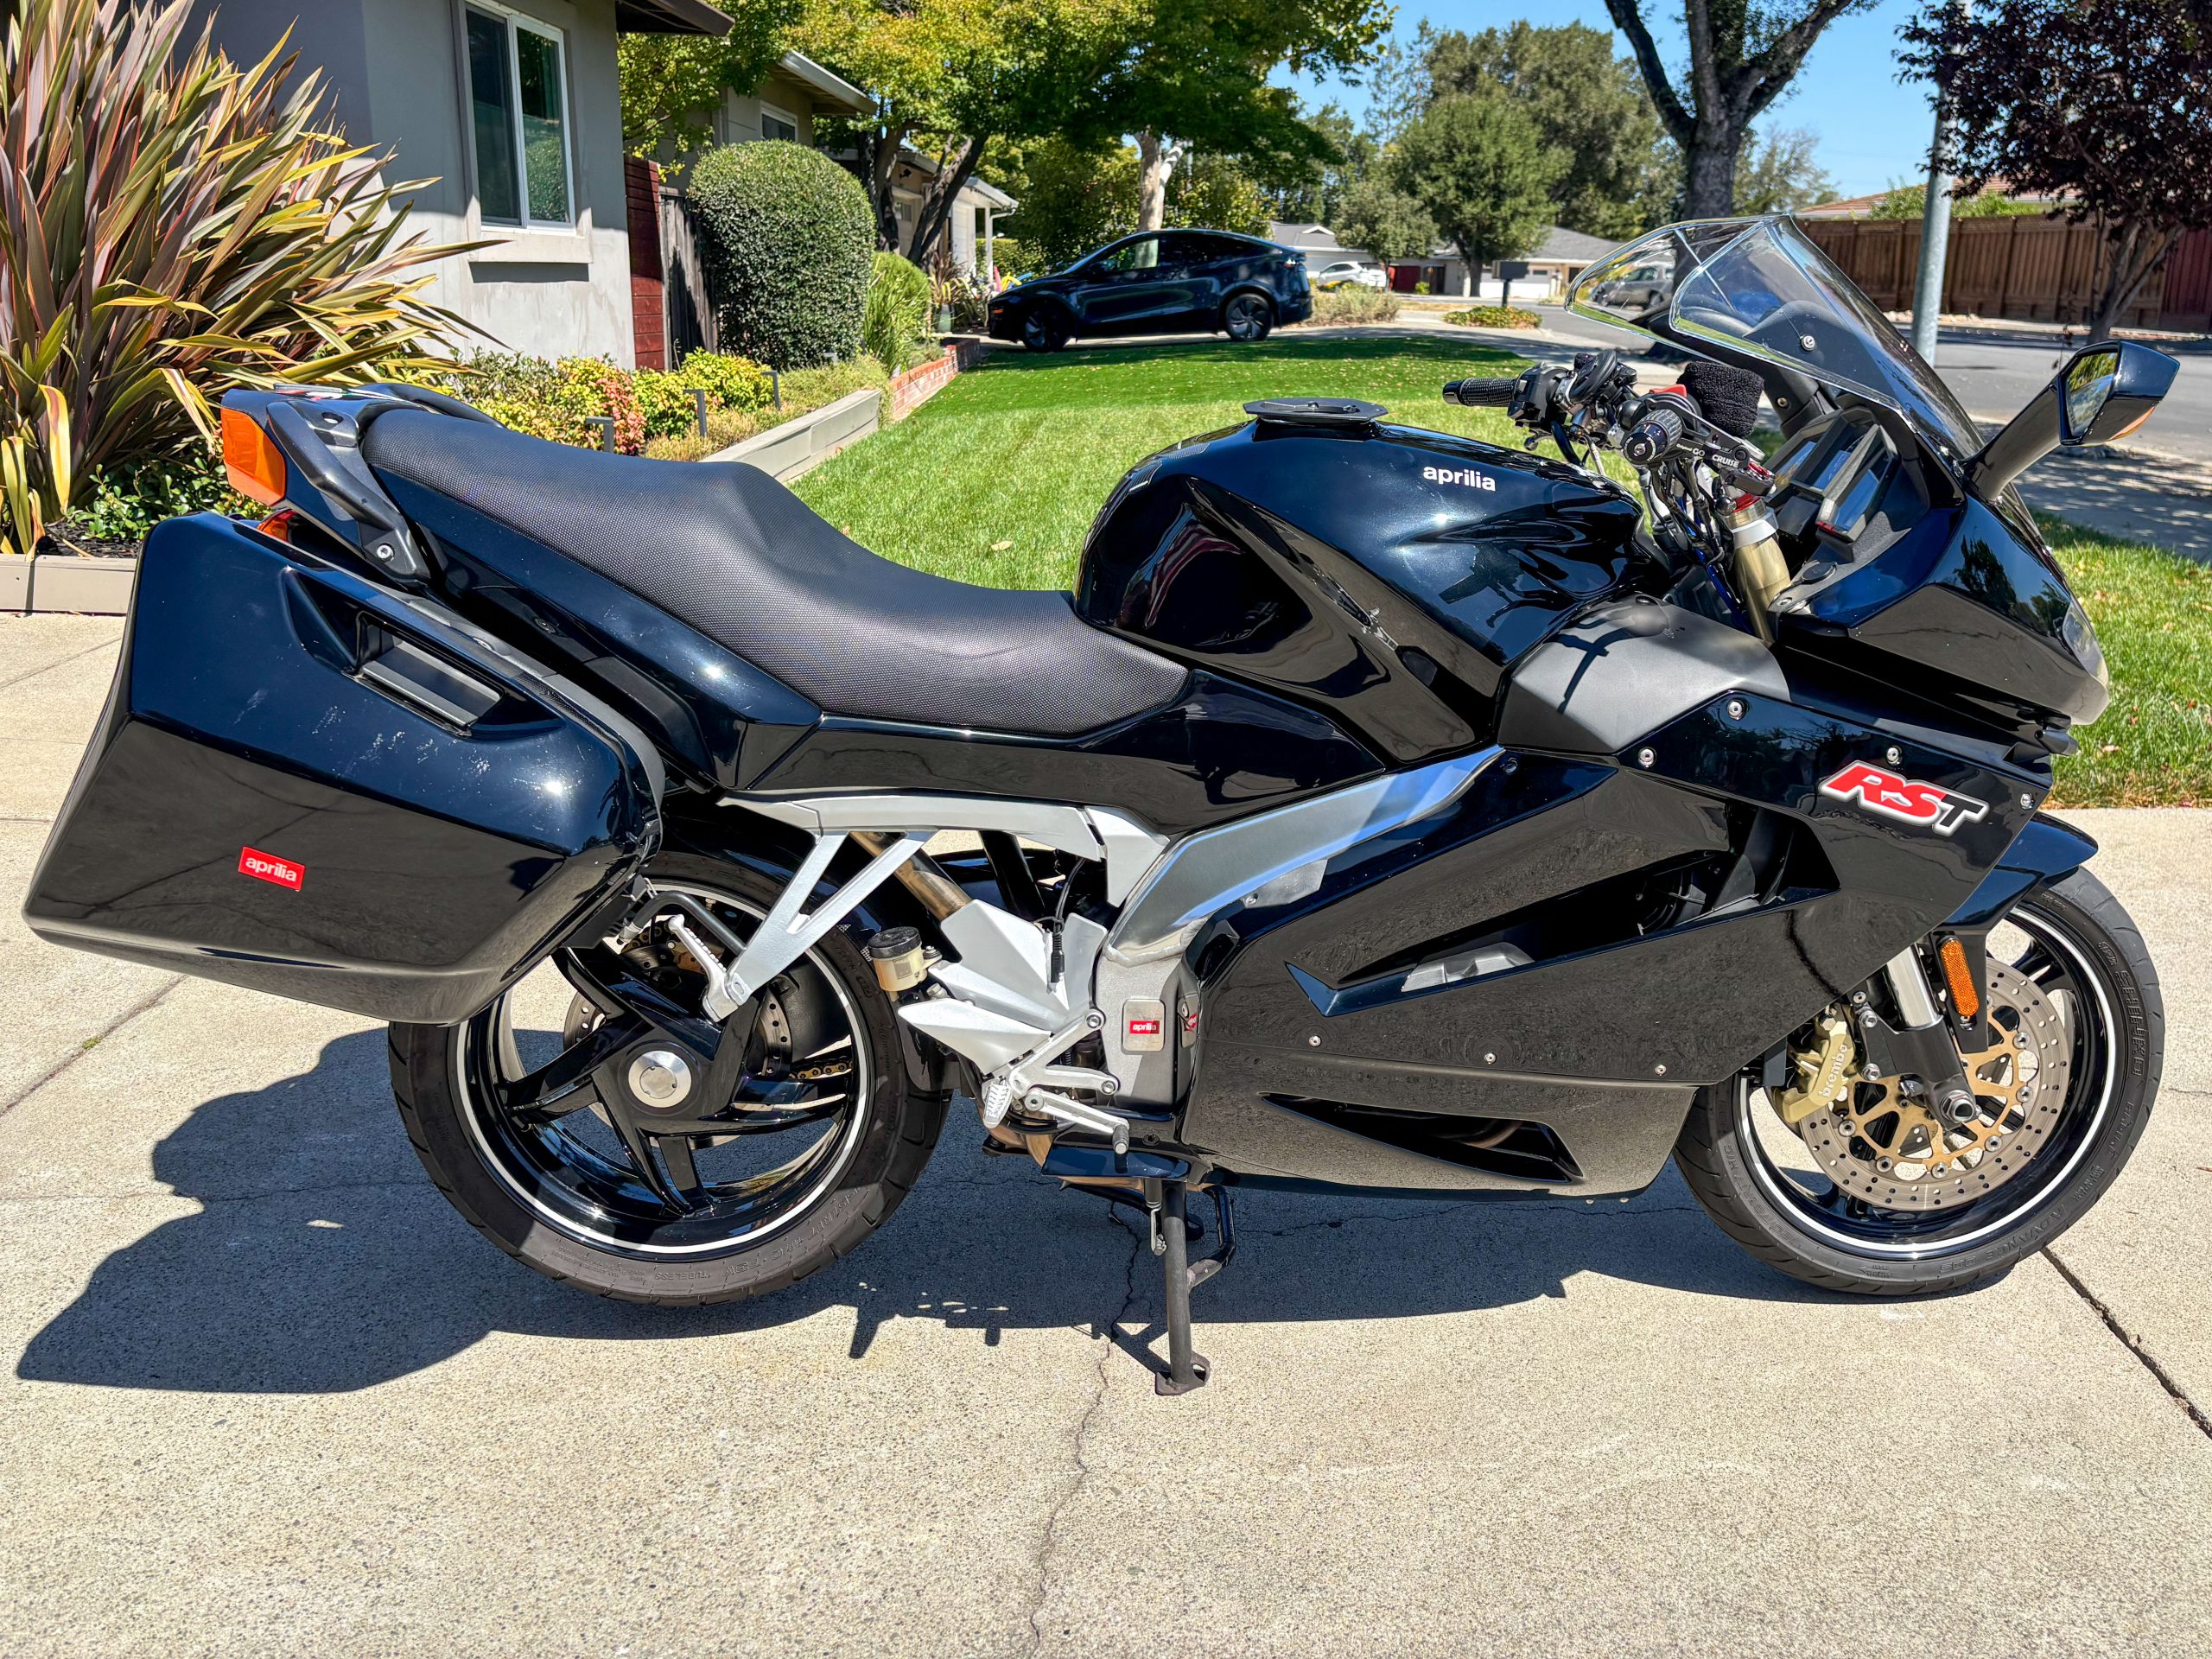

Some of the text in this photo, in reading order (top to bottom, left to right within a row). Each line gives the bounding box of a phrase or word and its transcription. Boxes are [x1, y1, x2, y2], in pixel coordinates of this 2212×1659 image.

[1692, 448, 1706, 457] GO
[1712, 454, 1740, 468] CRUISE
[1422, 466, 1497, 492] aprilia
[1820, 761, 1988, 836] RST
[245, 857, 297, 882] aprilia
[1132, 1022, 1157, 1032] aprilia
[1817, 1043, 1848, 1098] brembo
[654, 1271, 707, 1281] TUBELESS
